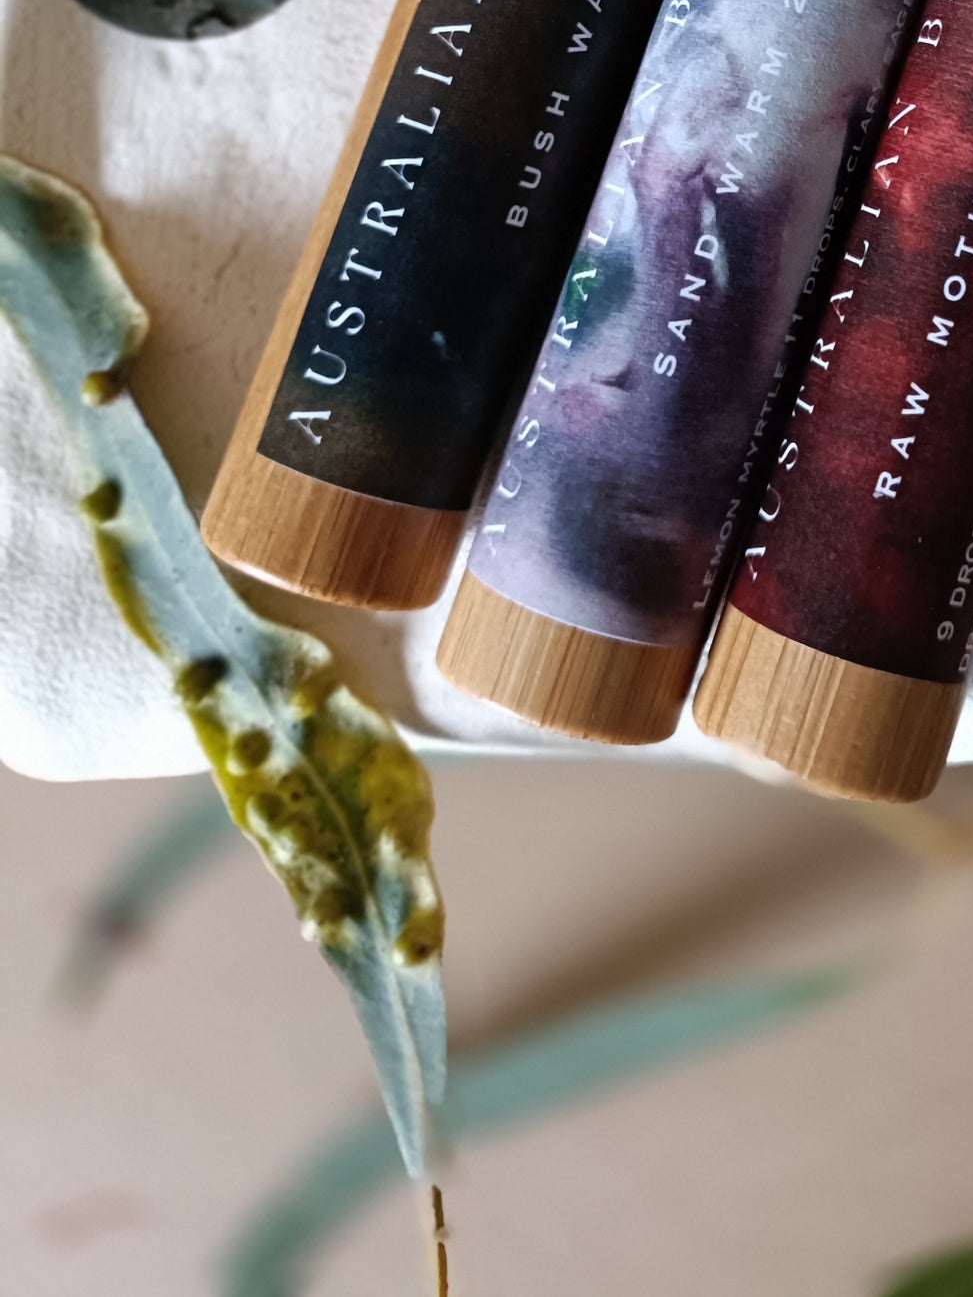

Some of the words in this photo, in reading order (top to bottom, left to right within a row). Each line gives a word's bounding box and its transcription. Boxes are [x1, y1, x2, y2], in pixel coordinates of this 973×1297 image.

[482, 75, 665, 556] AUSTRALIAN
[505, 91, 570, 228] BUSH
[654, 233, 720, 378] SAND
[716, 47, 789, 195] WARM
[692, 498, 741, 610] LEMON
[738, 360, 787, 483] MYRTLE
[785, 313, 804, 343] 11
[847, 76, 885, 173] CLARY
[744, 98, 917, 582] AUSTRALIAN
[873, 382, 930, 499] RAW
[937, 620, 955, 641] 9
